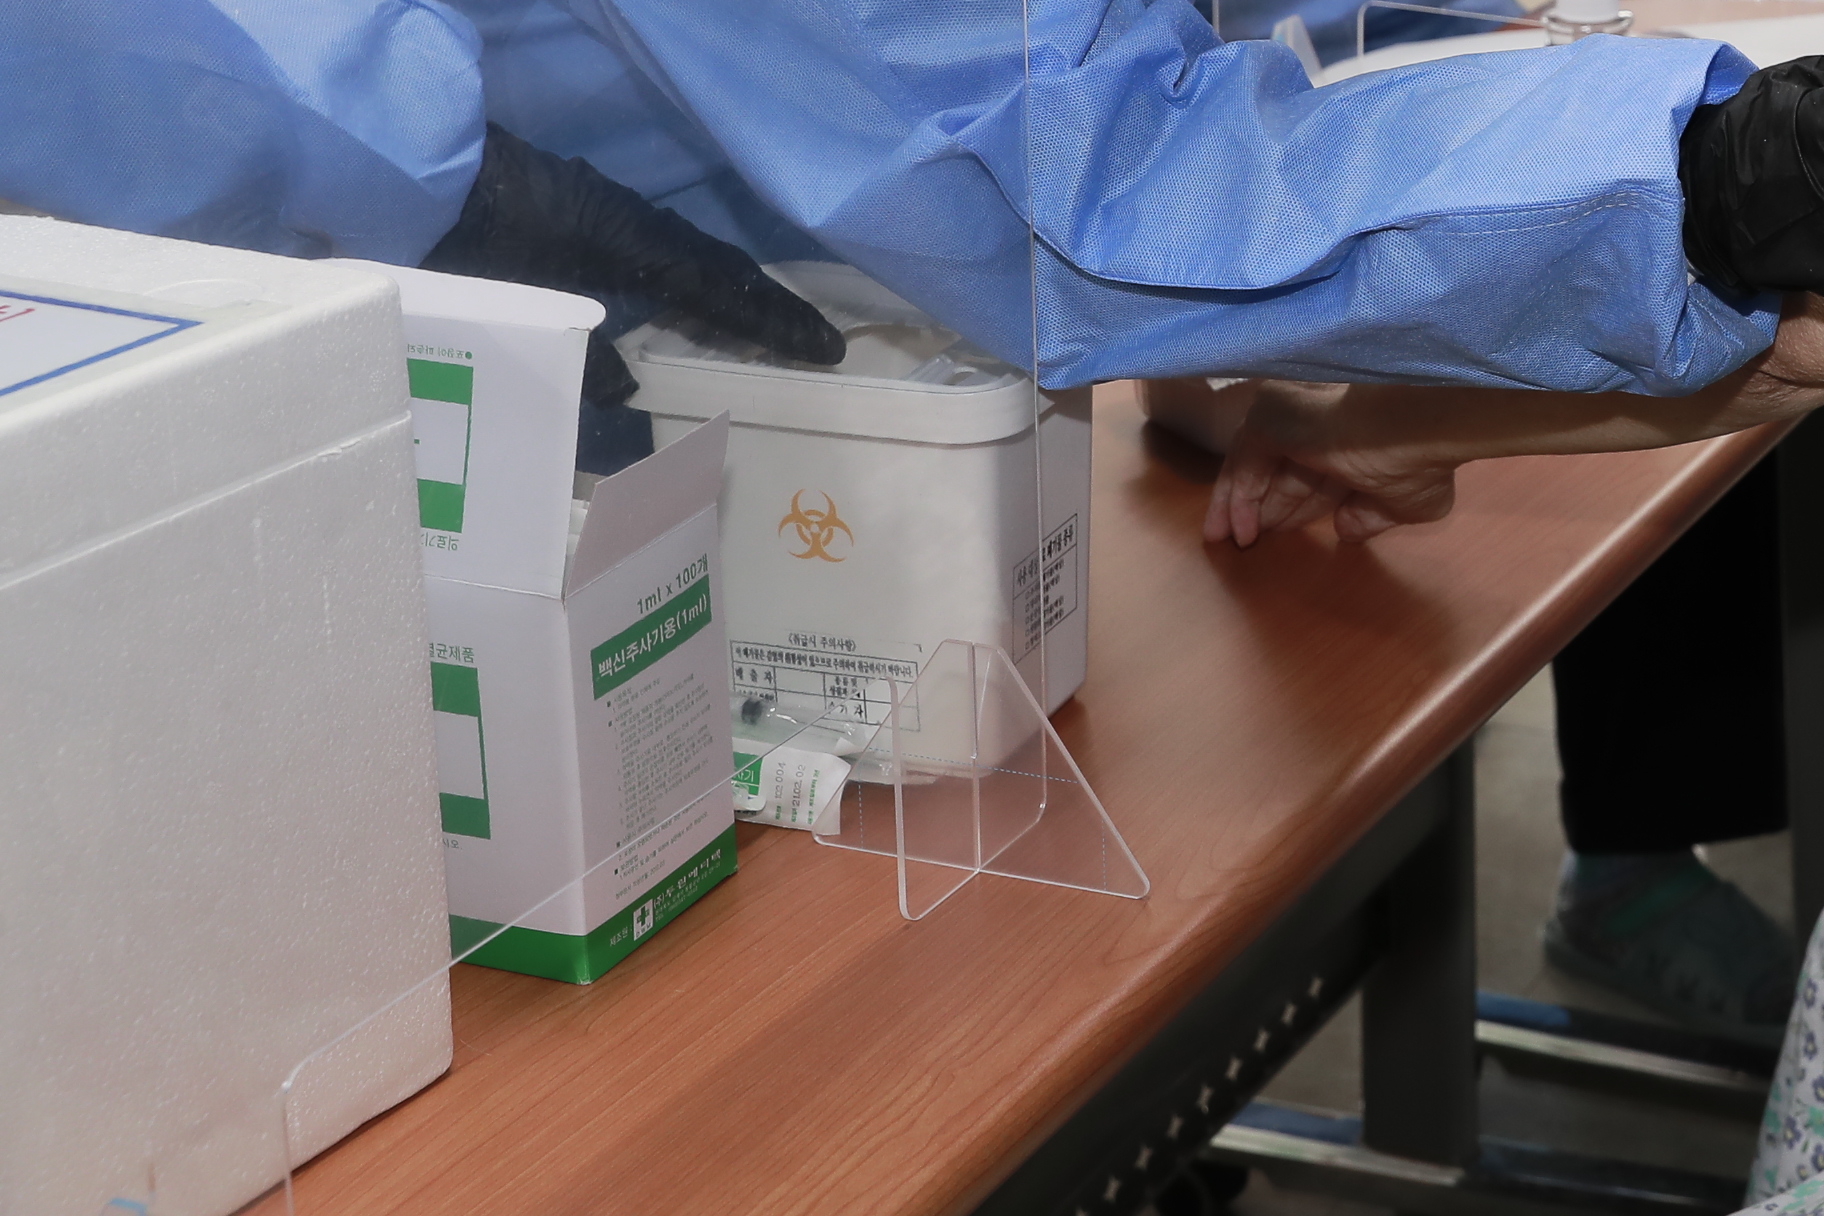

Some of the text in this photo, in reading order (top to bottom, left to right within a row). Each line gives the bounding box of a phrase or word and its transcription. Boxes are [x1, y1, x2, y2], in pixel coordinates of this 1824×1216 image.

[637, 587, 662, 614] 1ml
[675, 553, 709, 589] 100개
[598, 593, 707, 677] 백신주사기용(1ml)
